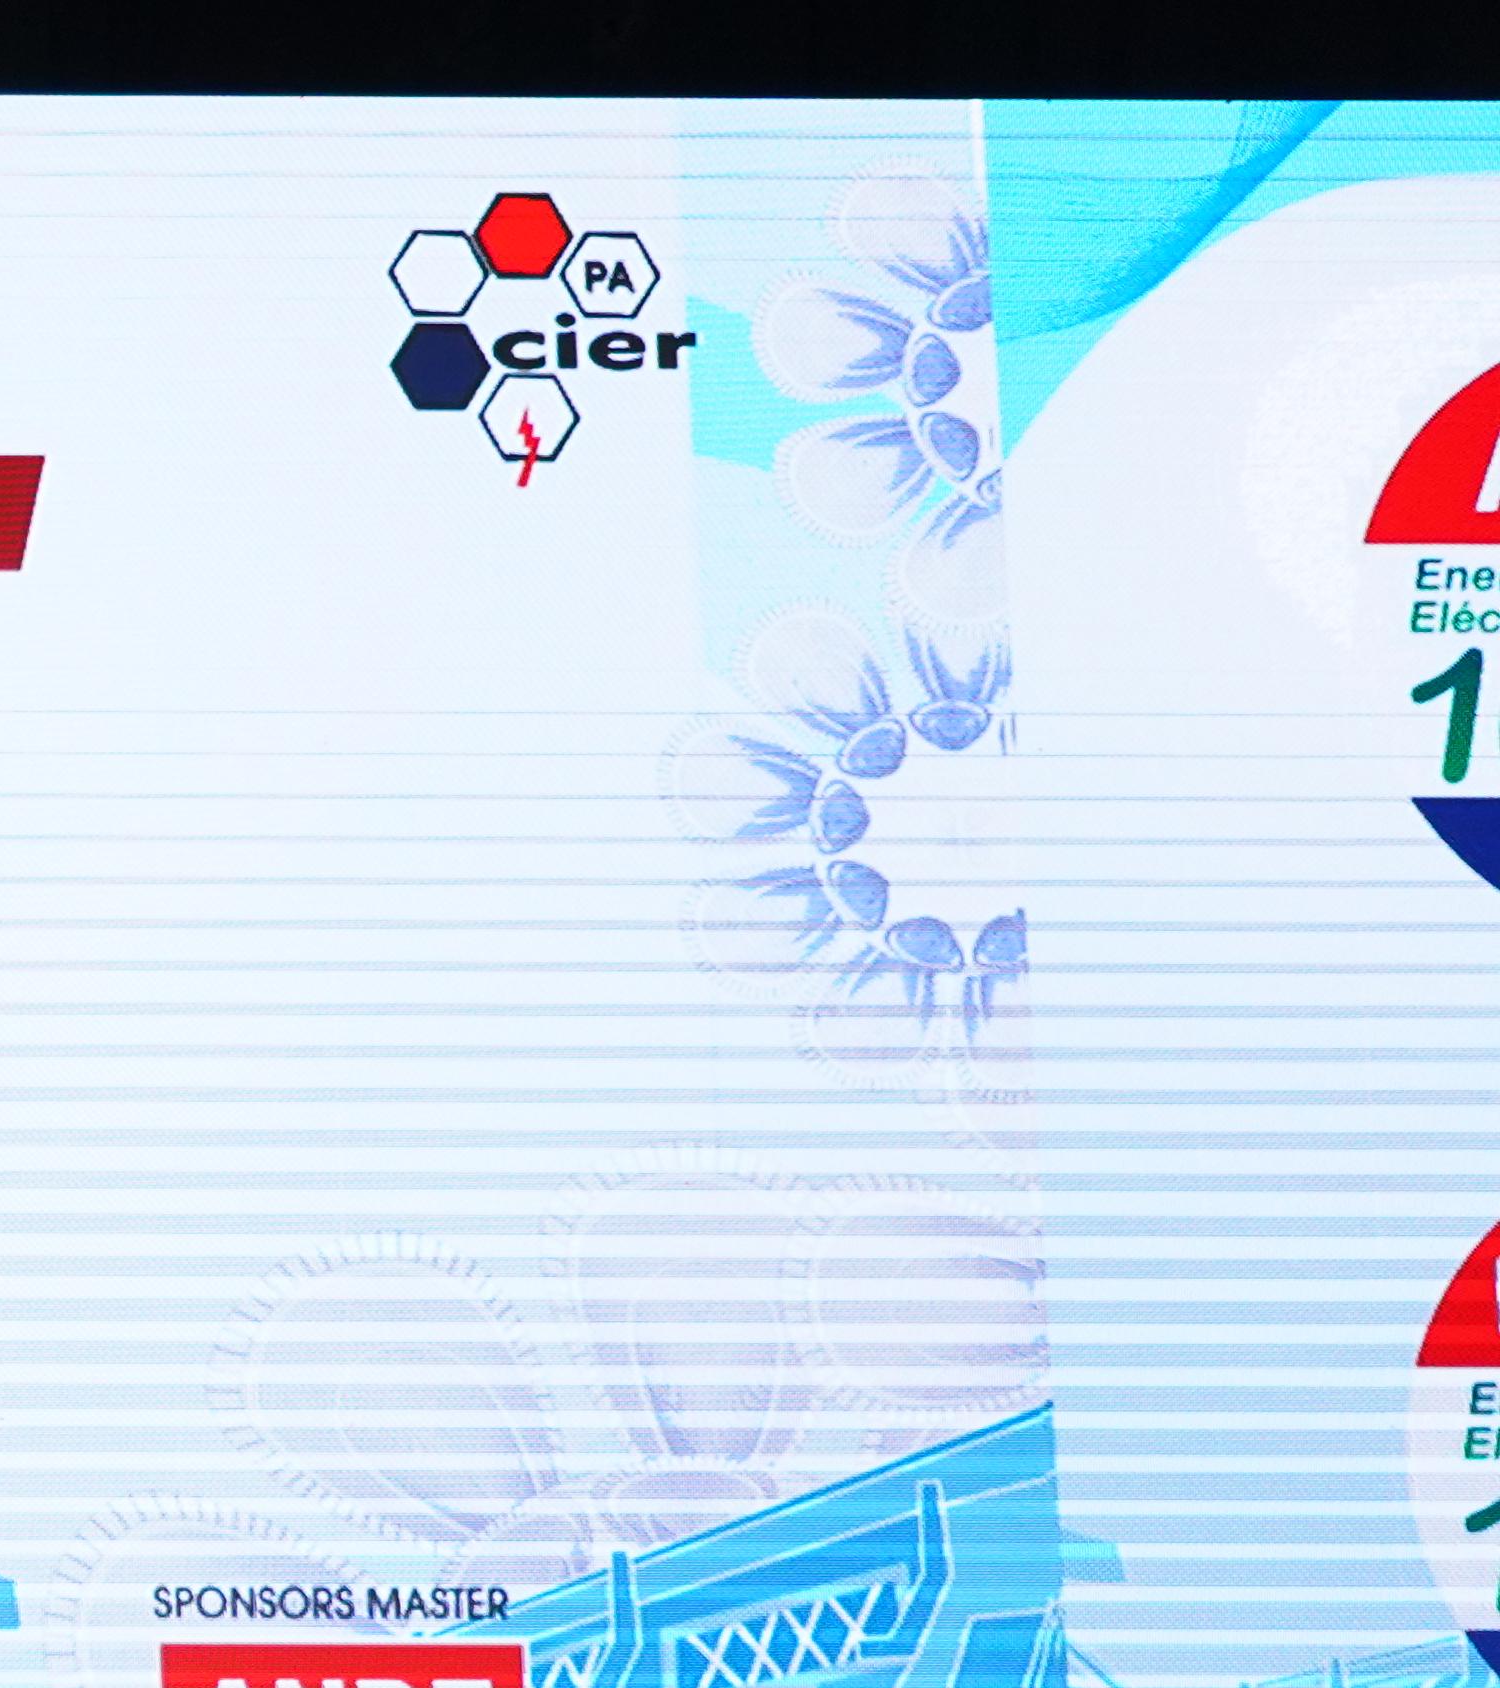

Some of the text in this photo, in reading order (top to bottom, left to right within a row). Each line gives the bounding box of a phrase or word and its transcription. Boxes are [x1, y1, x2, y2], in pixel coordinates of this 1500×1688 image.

[584, 261, 636, 294] PA
[493, 312, 698, 371] cier
[153, 1586, 509, 1620] SPONSORS MASTER
